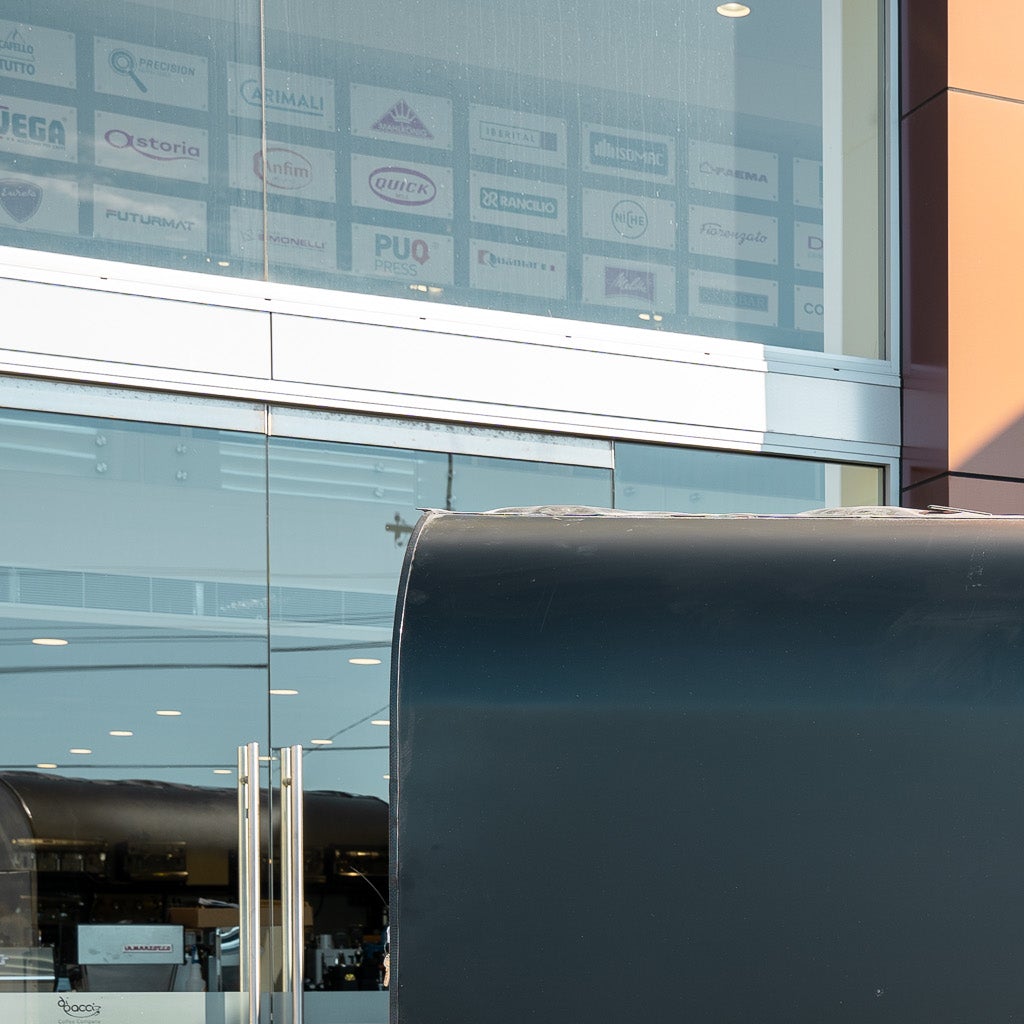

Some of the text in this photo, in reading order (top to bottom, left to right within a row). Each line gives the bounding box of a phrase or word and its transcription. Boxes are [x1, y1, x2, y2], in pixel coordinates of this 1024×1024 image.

[138, 58, 196, 77] PRECISION
[376, 177, 430, 195] QUICK
[499, 195, 556, 214] RANCILIO
[105, 208, 195, 232] FUTURMAT
[615, 211, 645, 229] NICHE
[700, 222, 768, 246] Fiorenzato
[375, 258, 418, 277] PRESS
